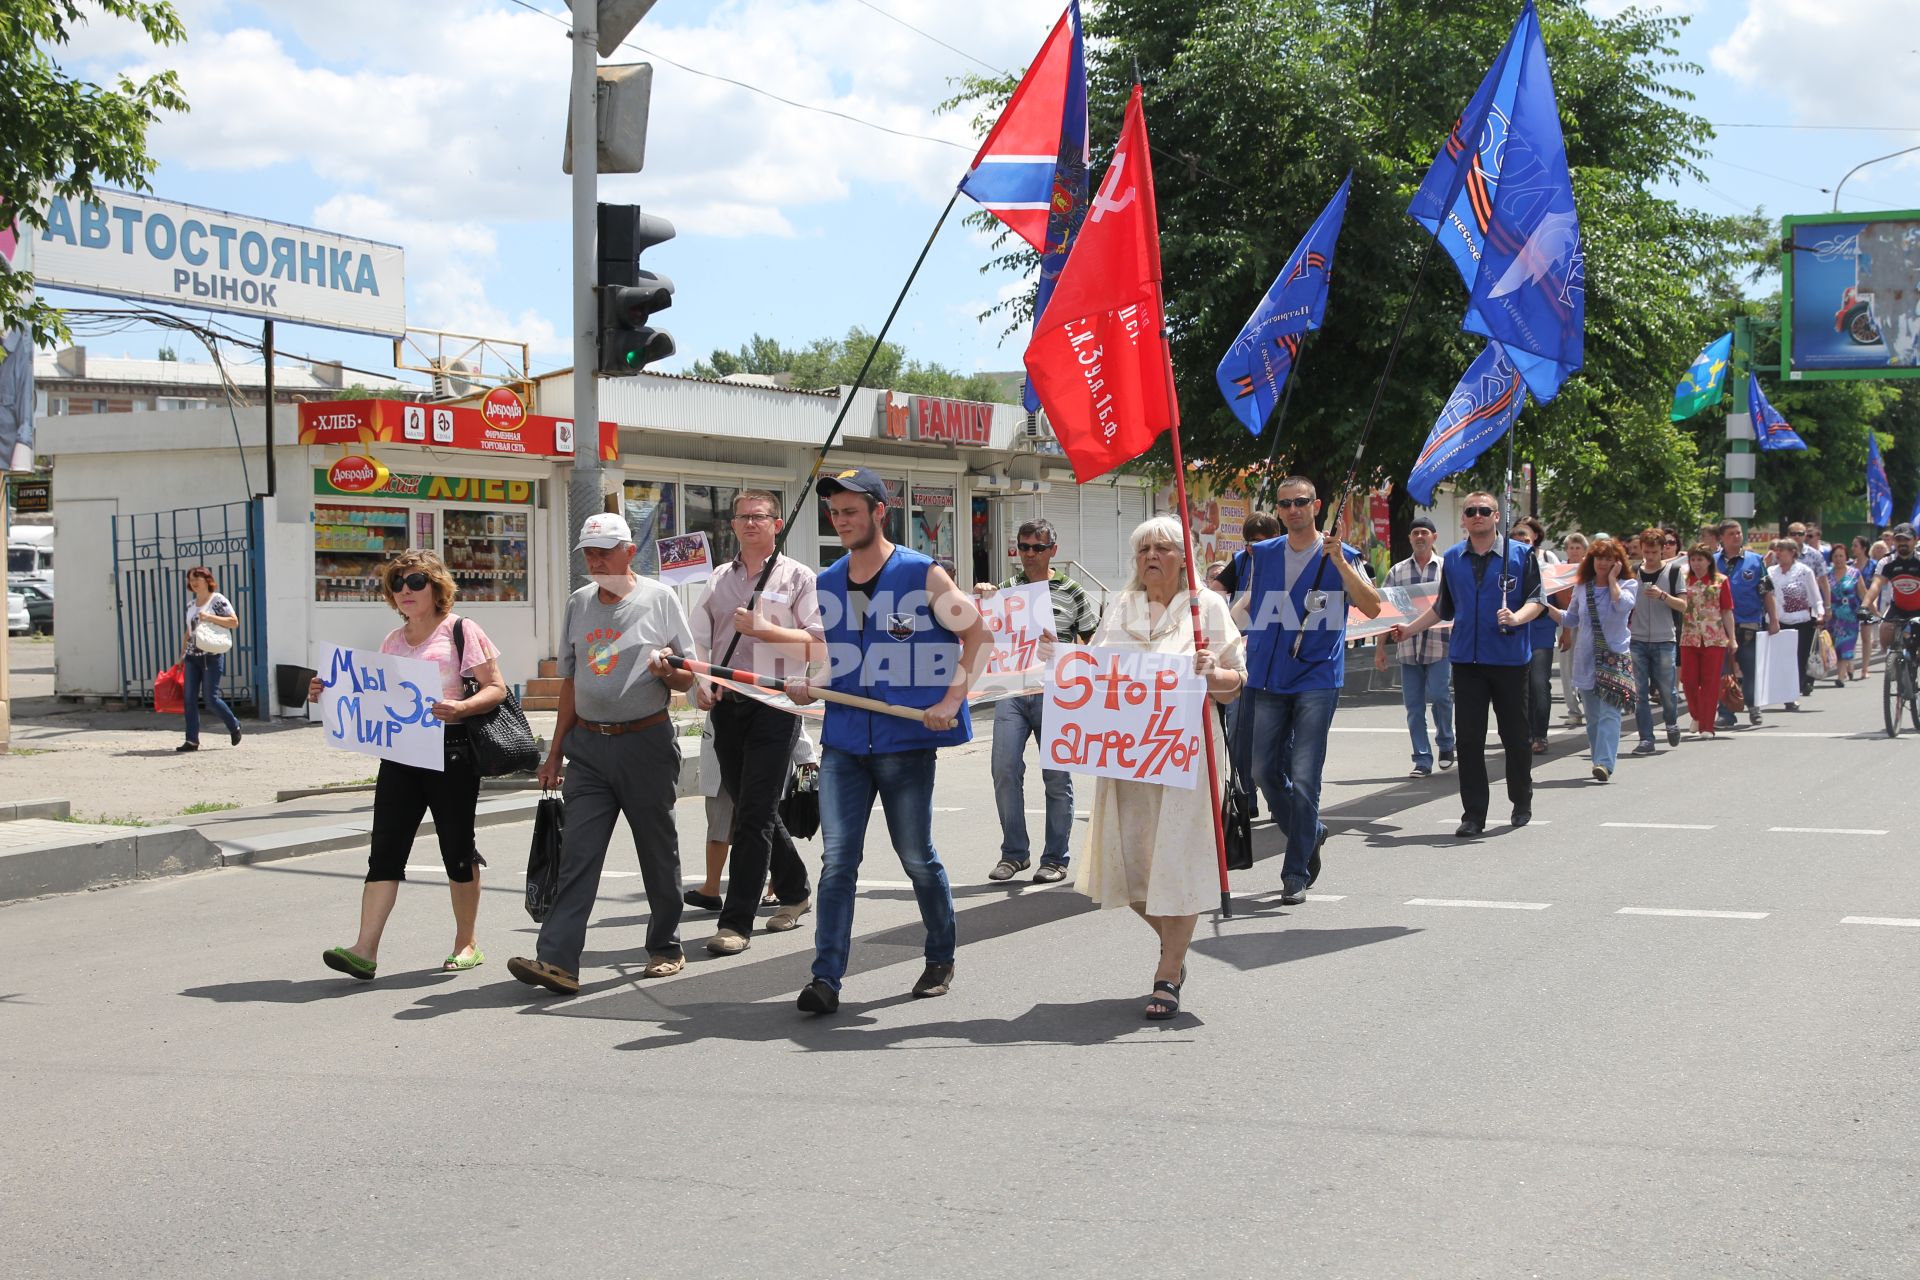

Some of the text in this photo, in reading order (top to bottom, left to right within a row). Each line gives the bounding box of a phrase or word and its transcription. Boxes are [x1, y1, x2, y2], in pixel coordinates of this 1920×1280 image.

[42, 195, 380, 297] АВТОСТОЯНКА
[173, 268, 278, 308] РЫНОК
[318, 413, 357, 430] ХЛЕБ
[485, 429, 521, 440] ФИРМЕННАЯ
[885, 388, 995, 447] for FAMILY
[481, 440, 525, 452] ТОРГОВАЯ СЕТЬ
[914, 493, 953, 506] ТРИКОТАЖ
[322, 647, 388, 694] Мы
[1052, 650, 1179, 713] Stop
[332, 695, 403, 748] Мир
[384, 681, 442, 728] За
